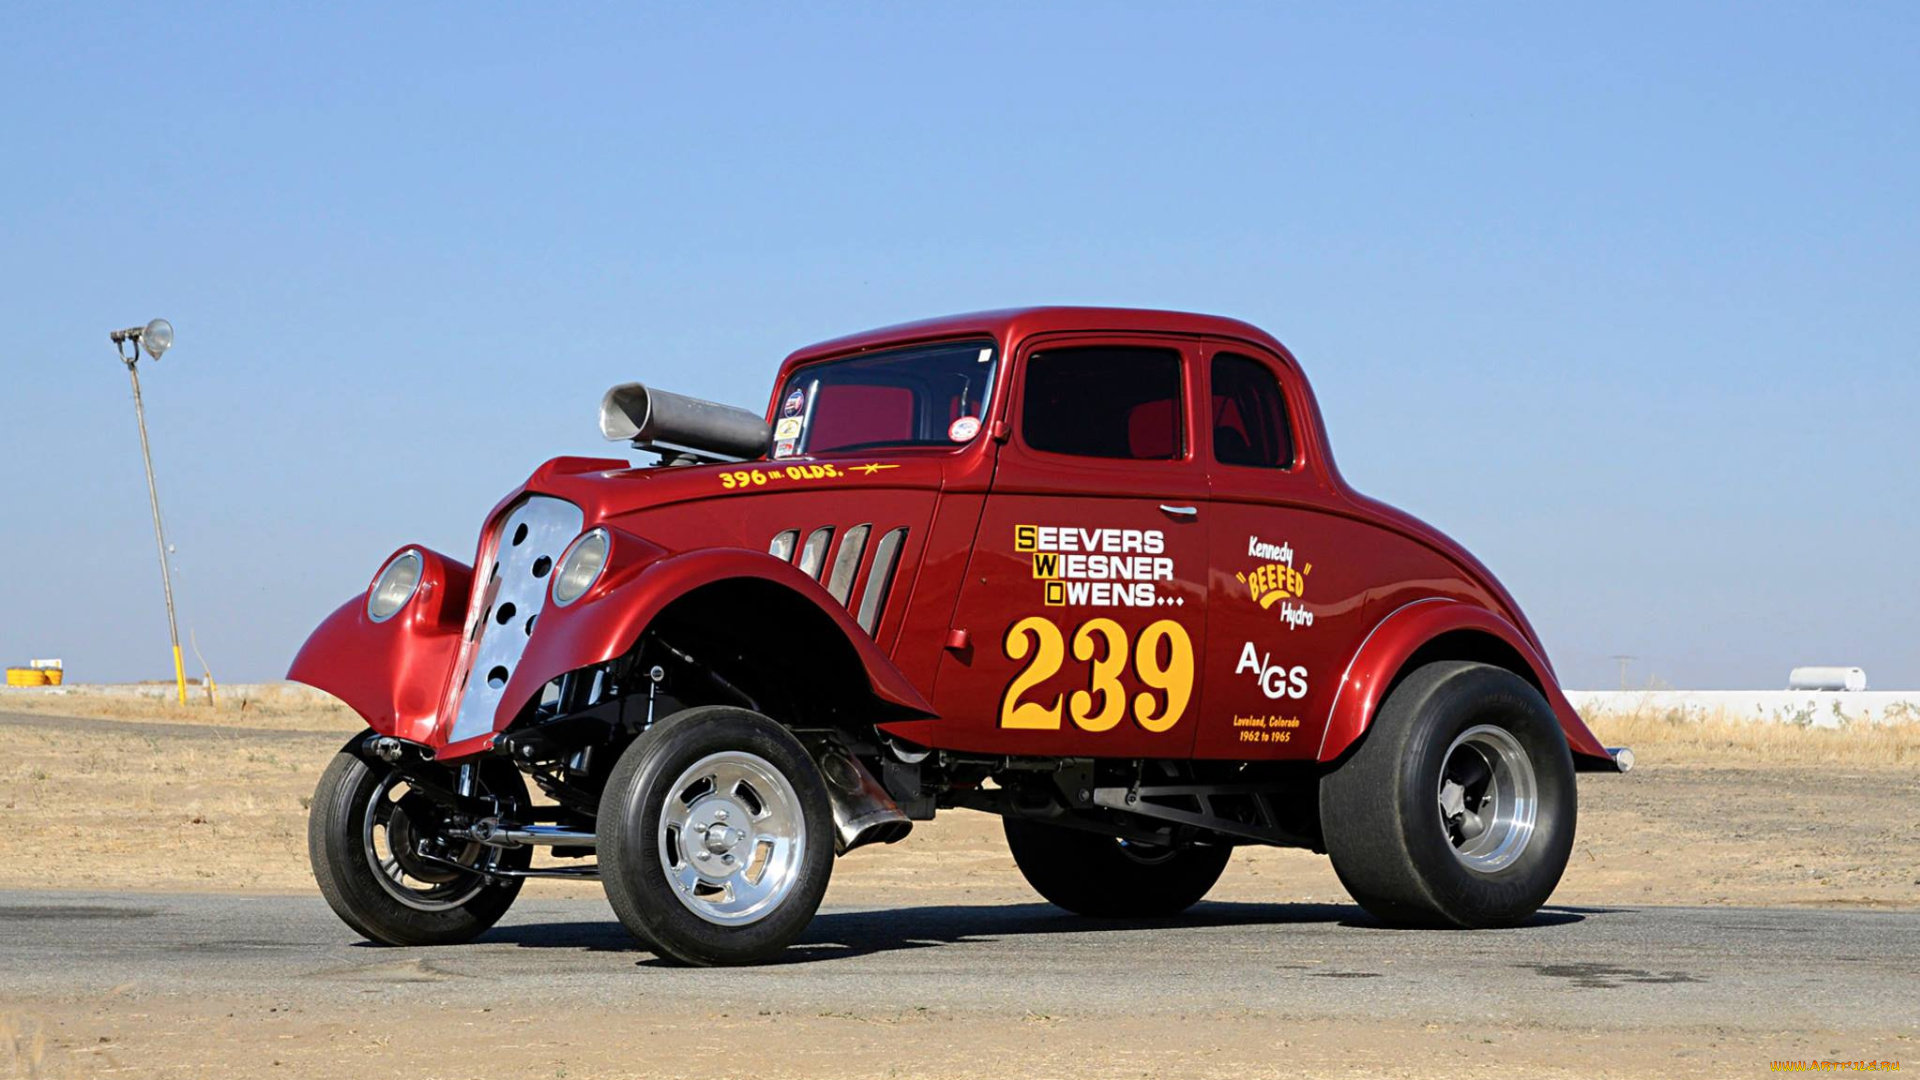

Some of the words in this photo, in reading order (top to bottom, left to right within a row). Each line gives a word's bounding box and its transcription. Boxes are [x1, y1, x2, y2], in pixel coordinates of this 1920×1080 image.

[718, 469, 767, 489] 396
[785, 464, 844, 480] OLDS.
[1016, 525, 1164, 554] SEEVERS
[1248, 535, 1293, 569] Kennedy
[1035, 553, 1173, 581] WIESNER
[1280, 601, 1314, 631] Hydro
[999, 616, 1195, 733] 239
[1235, 641, 1308, 699] A/GS
[1233, 714, 1267, 728] Loveland,
[1269, 715, 1300, 728] Colorado
[1240, 730, 1260, 742] 1962
[1261, 731, 1269, 742] to
[1271, 731, 1291, 743] 1965
